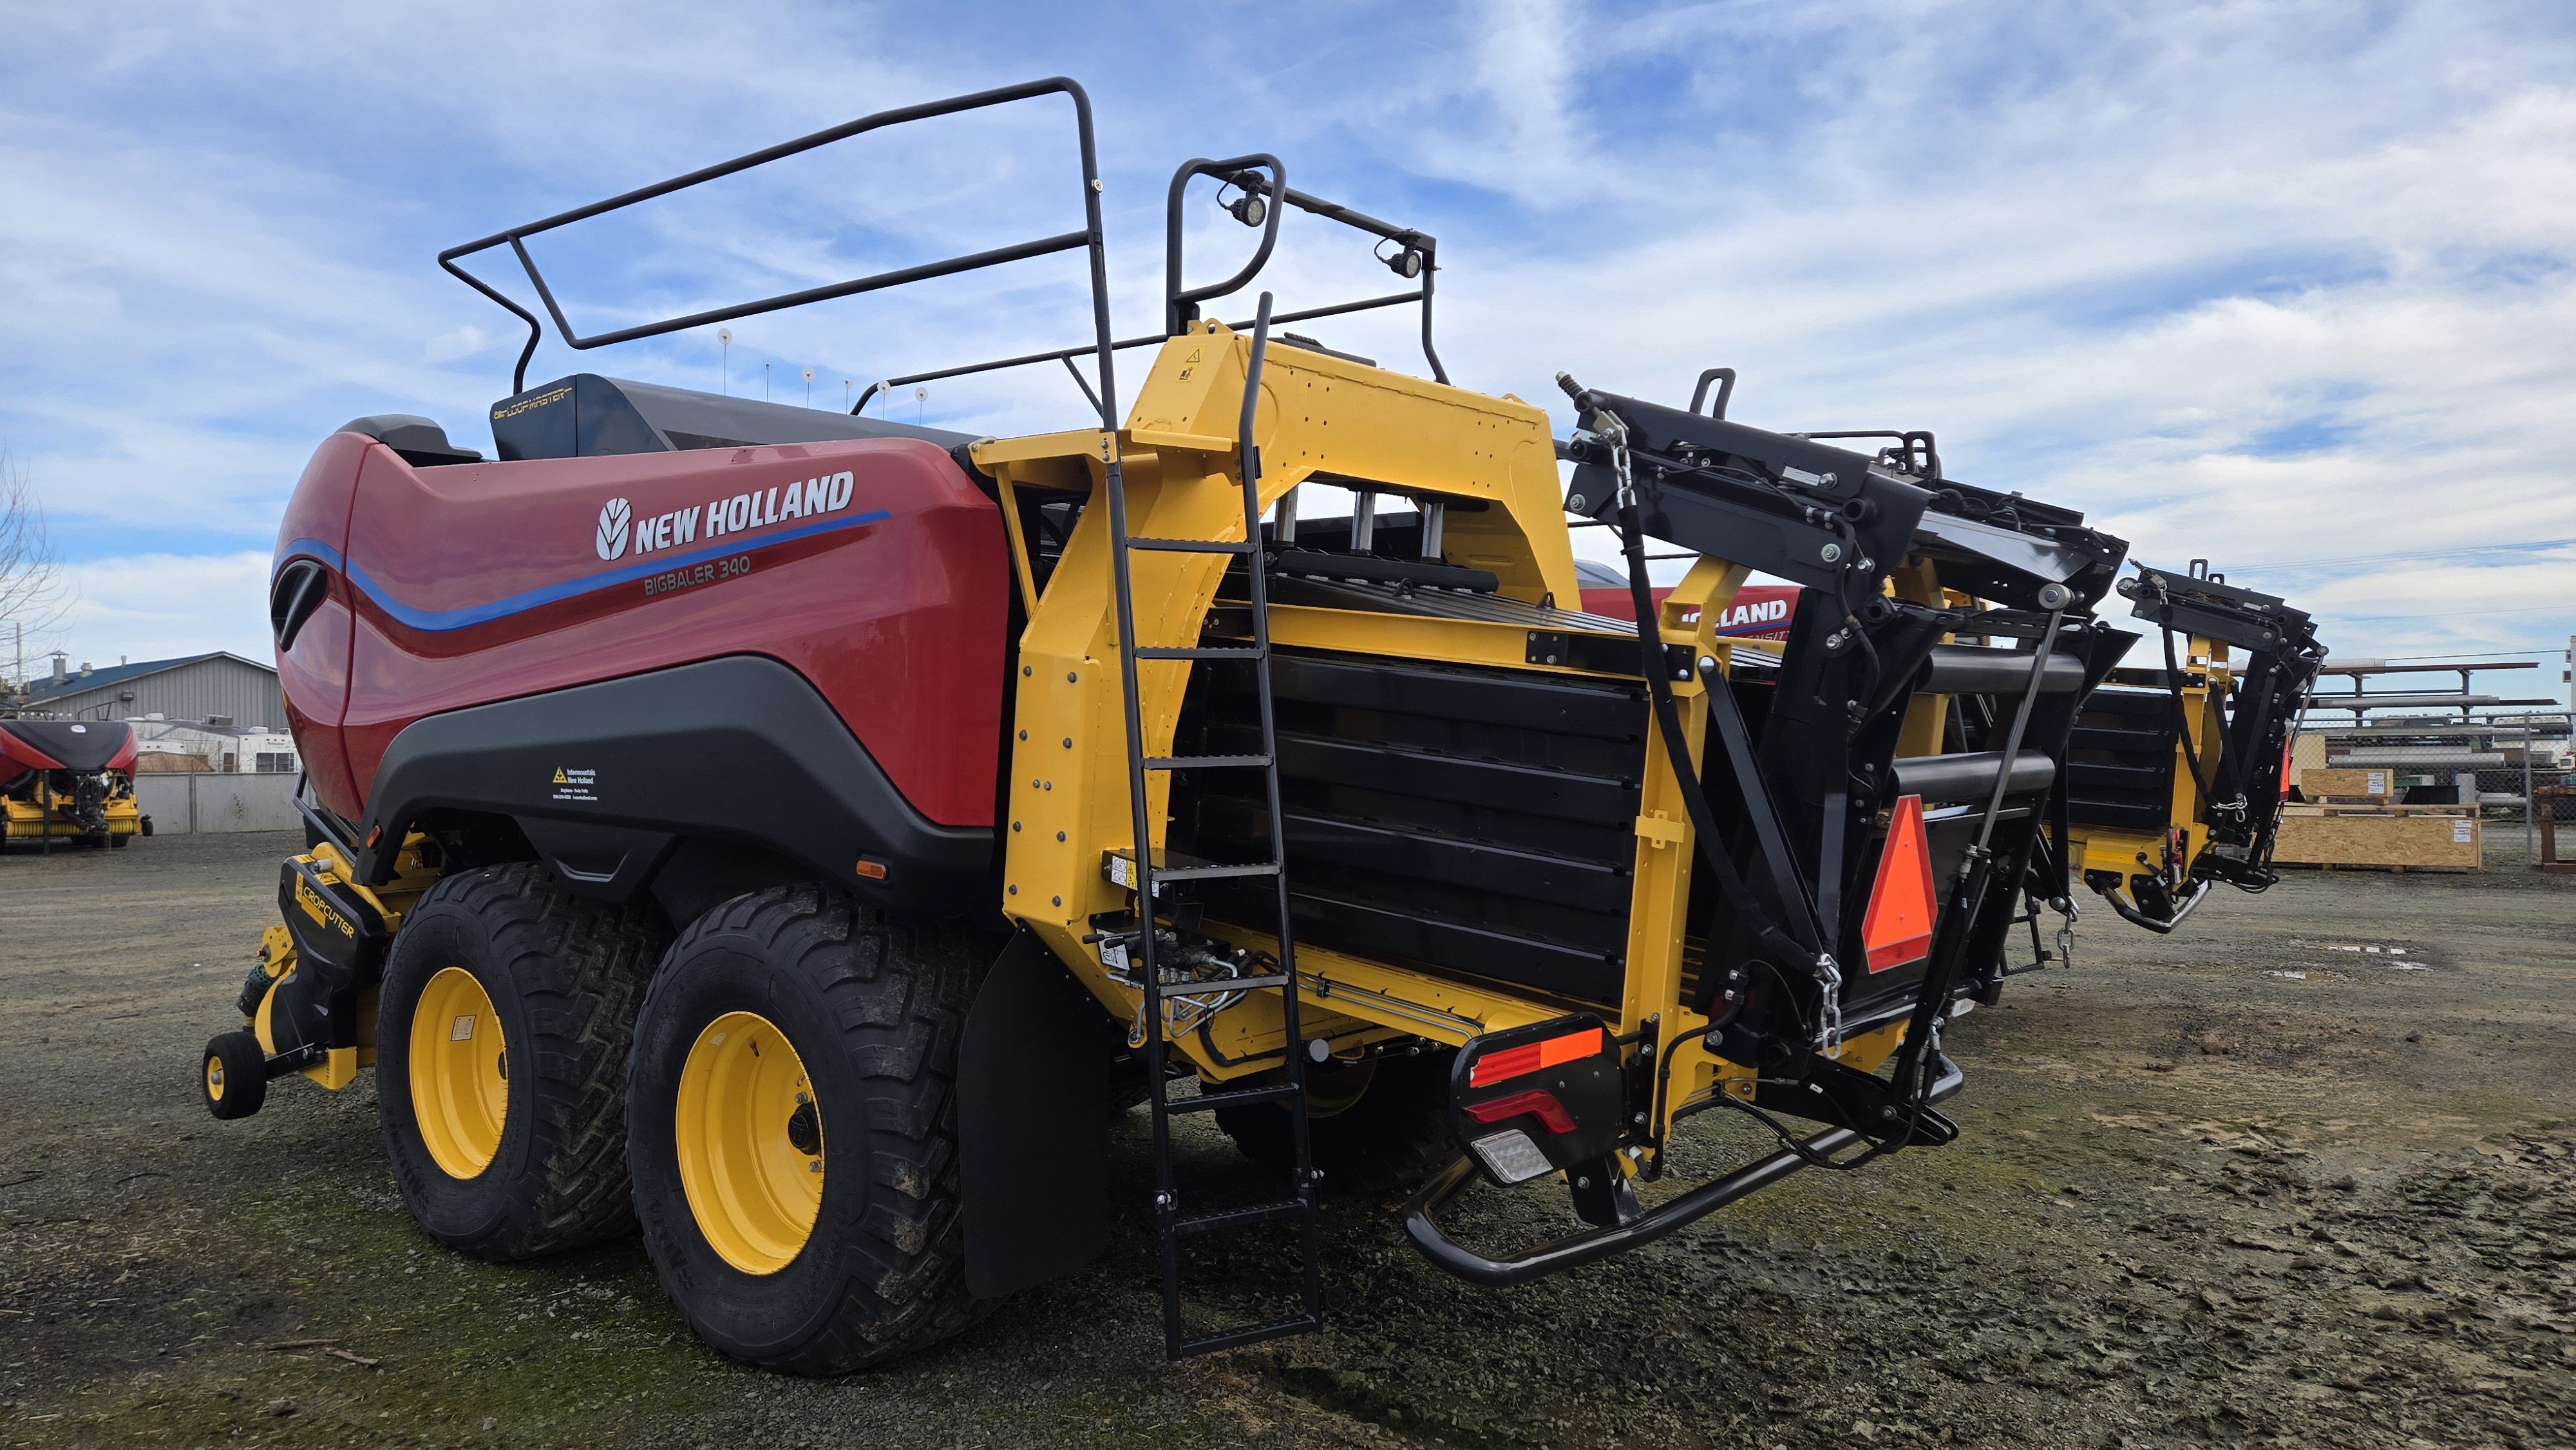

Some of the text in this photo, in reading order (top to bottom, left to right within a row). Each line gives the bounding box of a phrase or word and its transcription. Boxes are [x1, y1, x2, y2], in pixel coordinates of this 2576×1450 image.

[506, 388, 565, 417] LOOPMASTER
[635, 471, 855, 554] NEW HOLLAND
[645, 555, 750, 596] BIGBALER 340
[303, 886, 354, 939] CROPCUTTER
[386, 1104, 426, 1198] ALLIANCE
[638, 1142, 689, 1268] ALLIANCE
